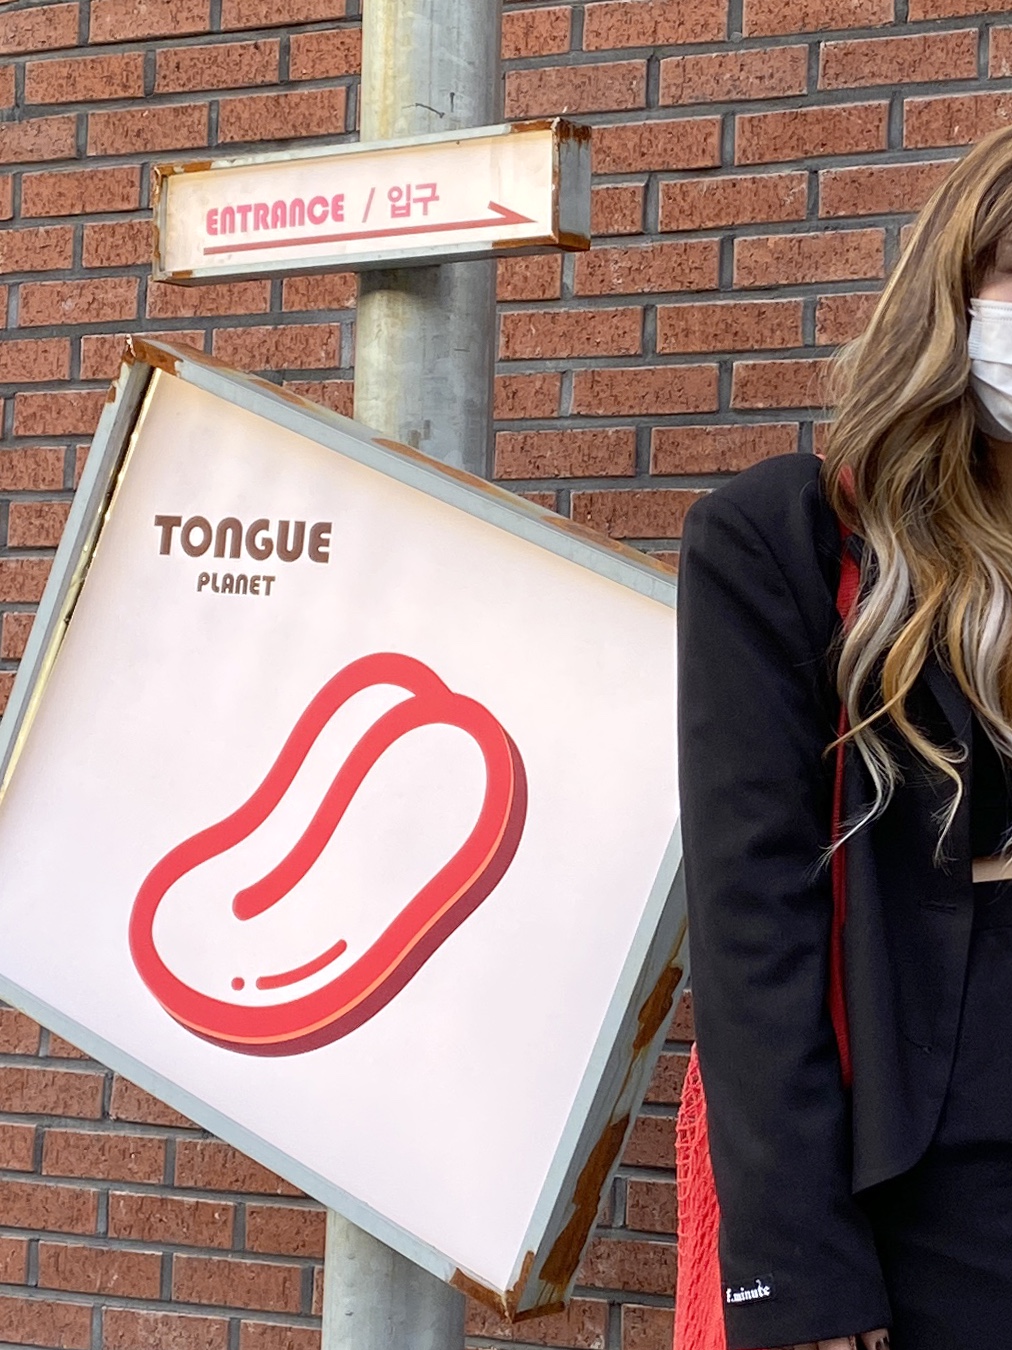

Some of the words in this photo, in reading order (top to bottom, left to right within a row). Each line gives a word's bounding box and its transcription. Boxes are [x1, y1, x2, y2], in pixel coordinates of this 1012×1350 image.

[206, 193, 344, 236] ENTRANCE
[362, 187, 376, 223] /
[387, 182, 440, 219] 입구
[154, 514, 333, 564] TONGUE
[196, 571, 277, 597] PLANET
